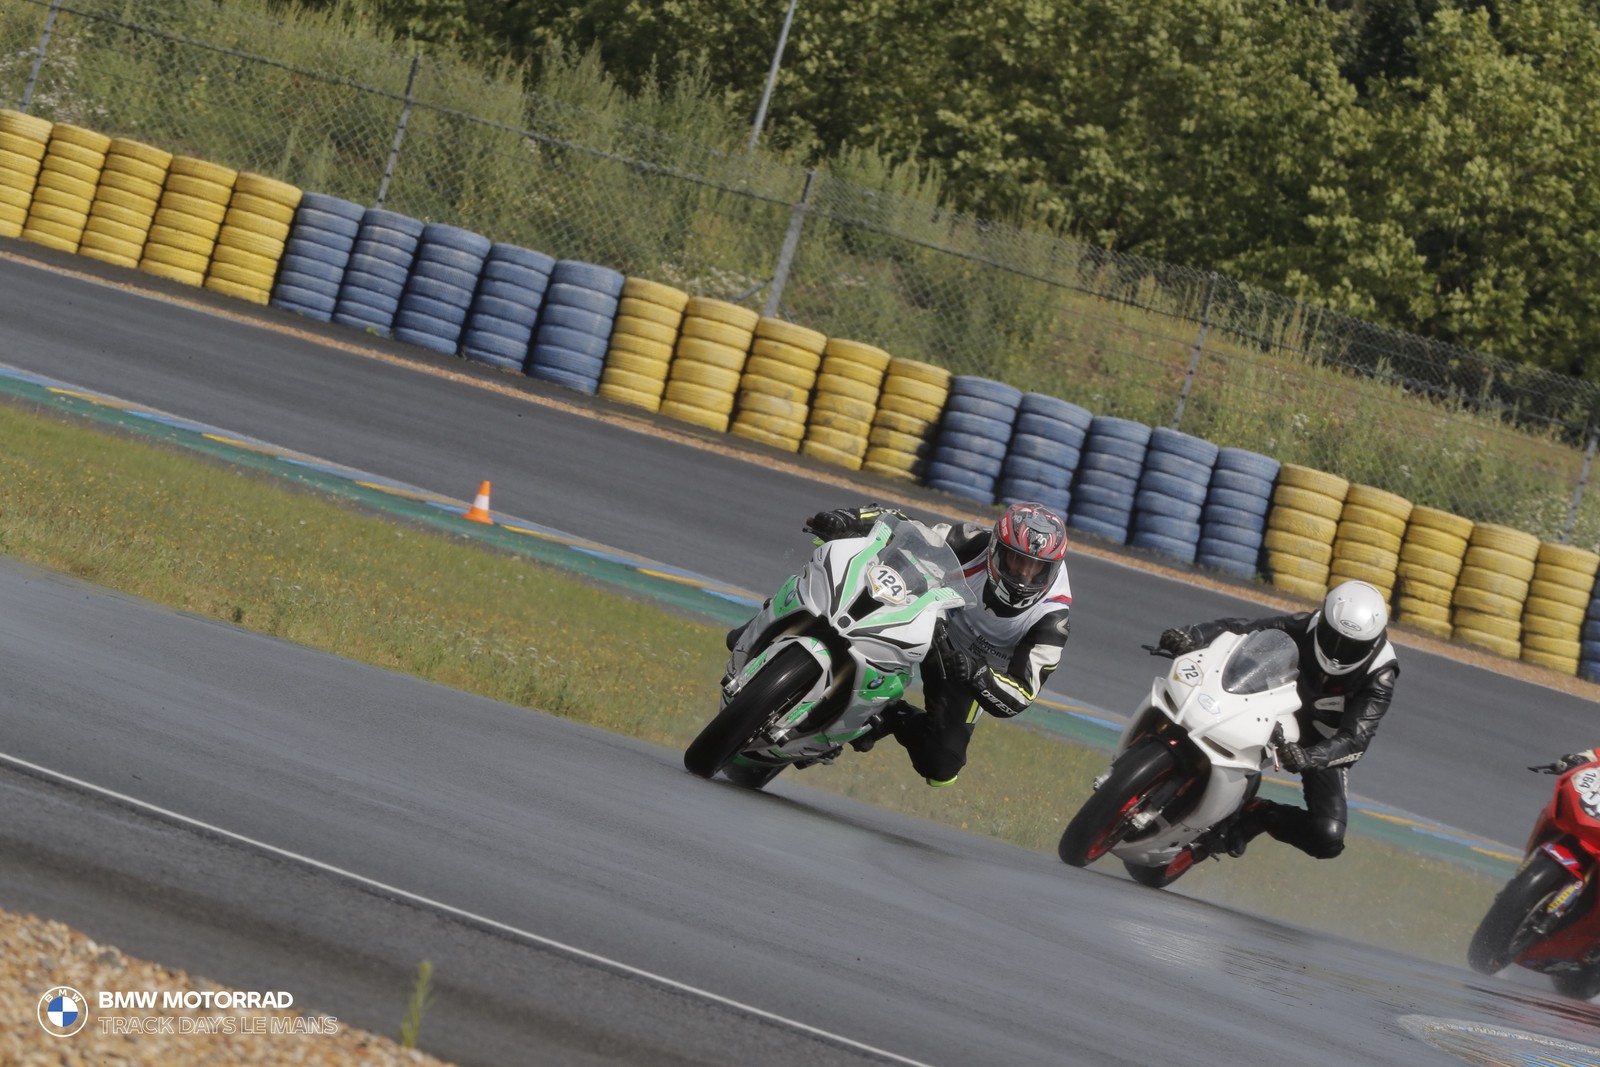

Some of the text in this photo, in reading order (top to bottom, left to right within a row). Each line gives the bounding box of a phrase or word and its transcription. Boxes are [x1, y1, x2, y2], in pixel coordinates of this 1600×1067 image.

[877, 570, 903, 597] 124
[1181, 665, 1199, 680] 72
[1579, 773, 1596, 788] 164
